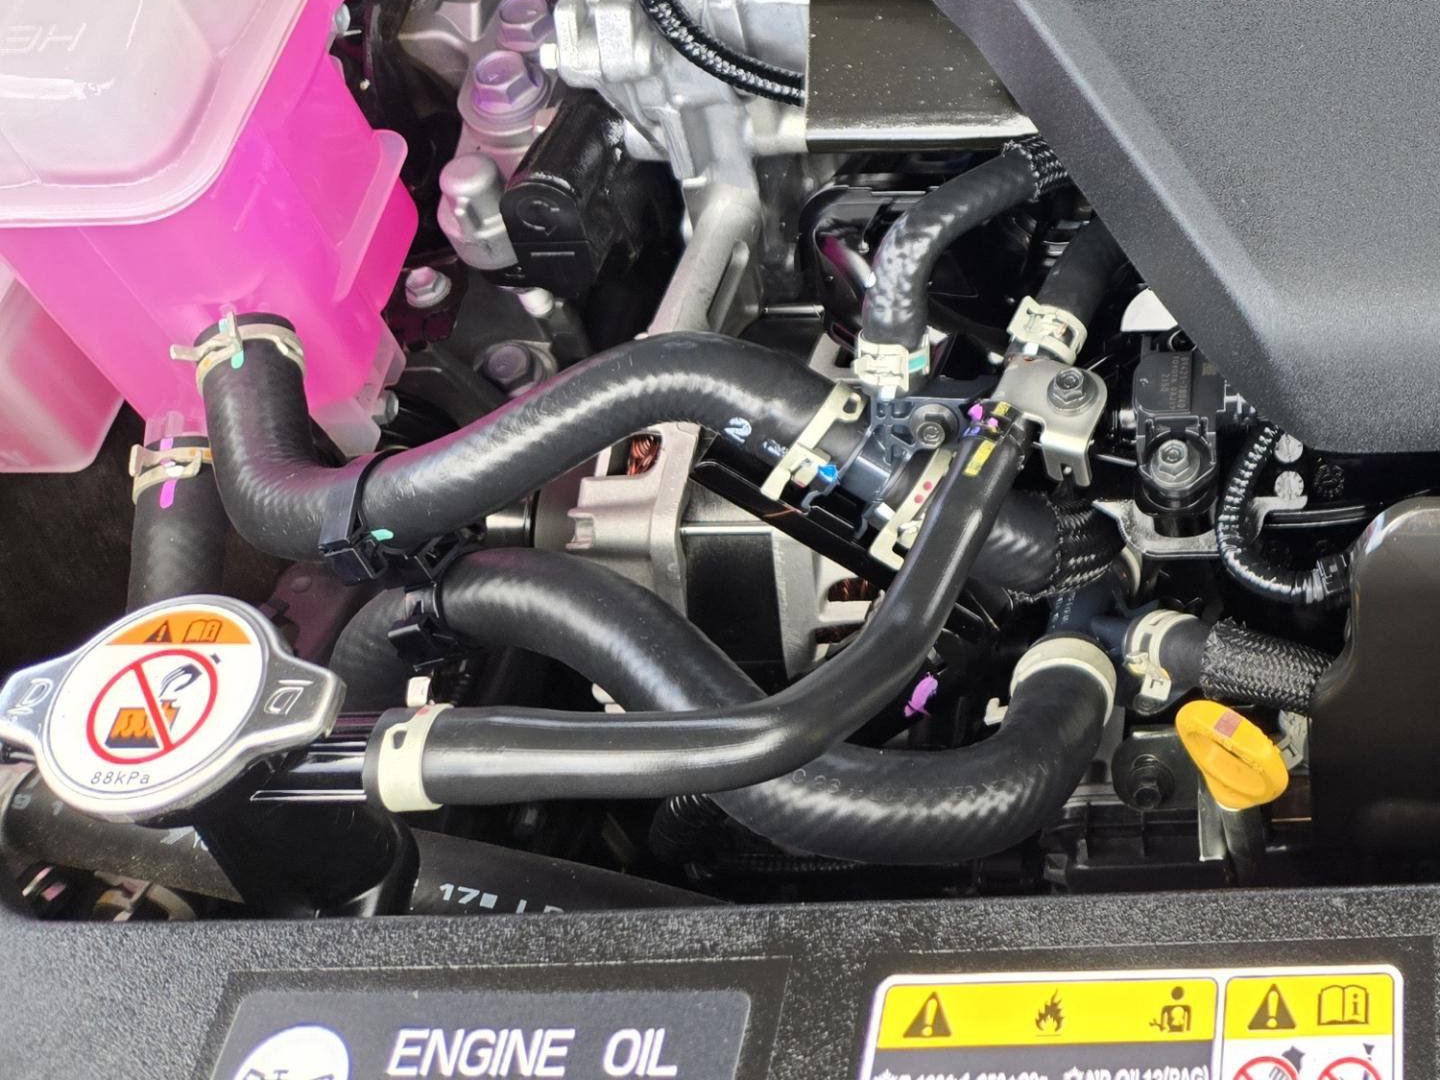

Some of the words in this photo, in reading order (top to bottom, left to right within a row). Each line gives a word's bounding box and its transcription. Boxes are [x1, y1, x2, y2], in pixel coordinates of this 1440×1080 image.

[90, 770, 151, 786] 88kPa
[386, 1028, 576, 1078] ENGINE
[602, 1028, 678, 1078] OIL
